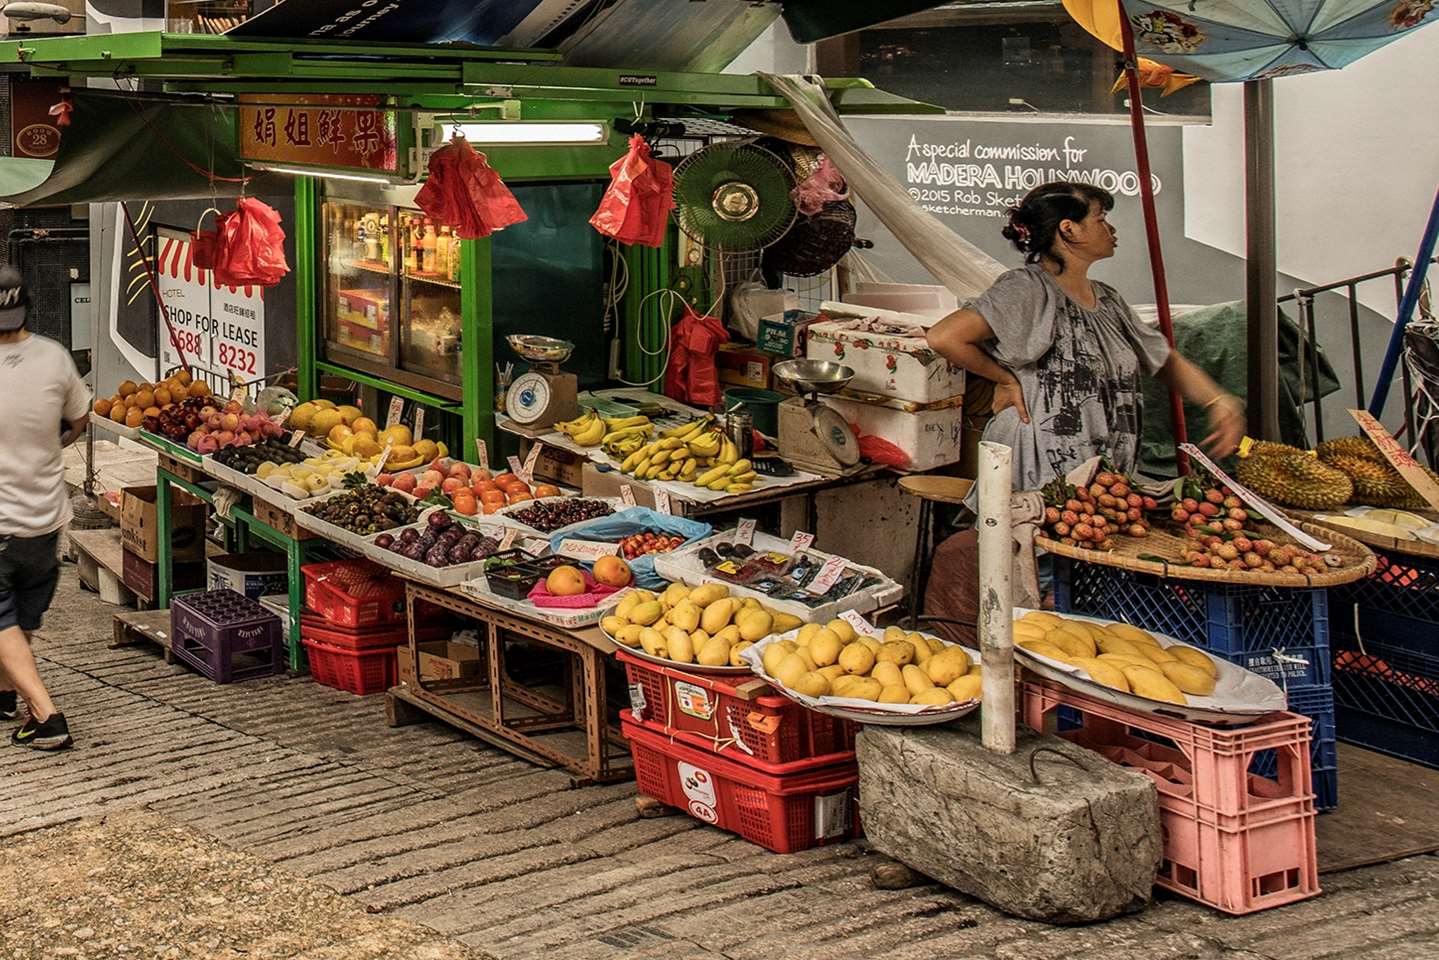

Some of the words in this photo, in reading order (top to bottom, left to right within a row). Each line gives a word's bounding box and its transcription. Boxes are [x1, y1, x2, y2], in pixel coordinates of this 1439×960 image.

[32, 134, 48, 145] 28
[254, 107, 380, 155] 娟姐鮮果
[906, 133, 921, 161] A
[922, 139, 971, 166] special
[974, 143, 1060, 162] commission
[1063, 136, 1088, 169] for
[907, 162, 1004, 189] MADERA
[954, 191, 982, 206] Rob
[987, 193, 1023, 208] Sket
[163, 304, 192, 326] SHOP
[195, 314, 219, 337] FOR
[223, 322, 258, 348] LEASE
[219, 342, 257, 375] 8232
